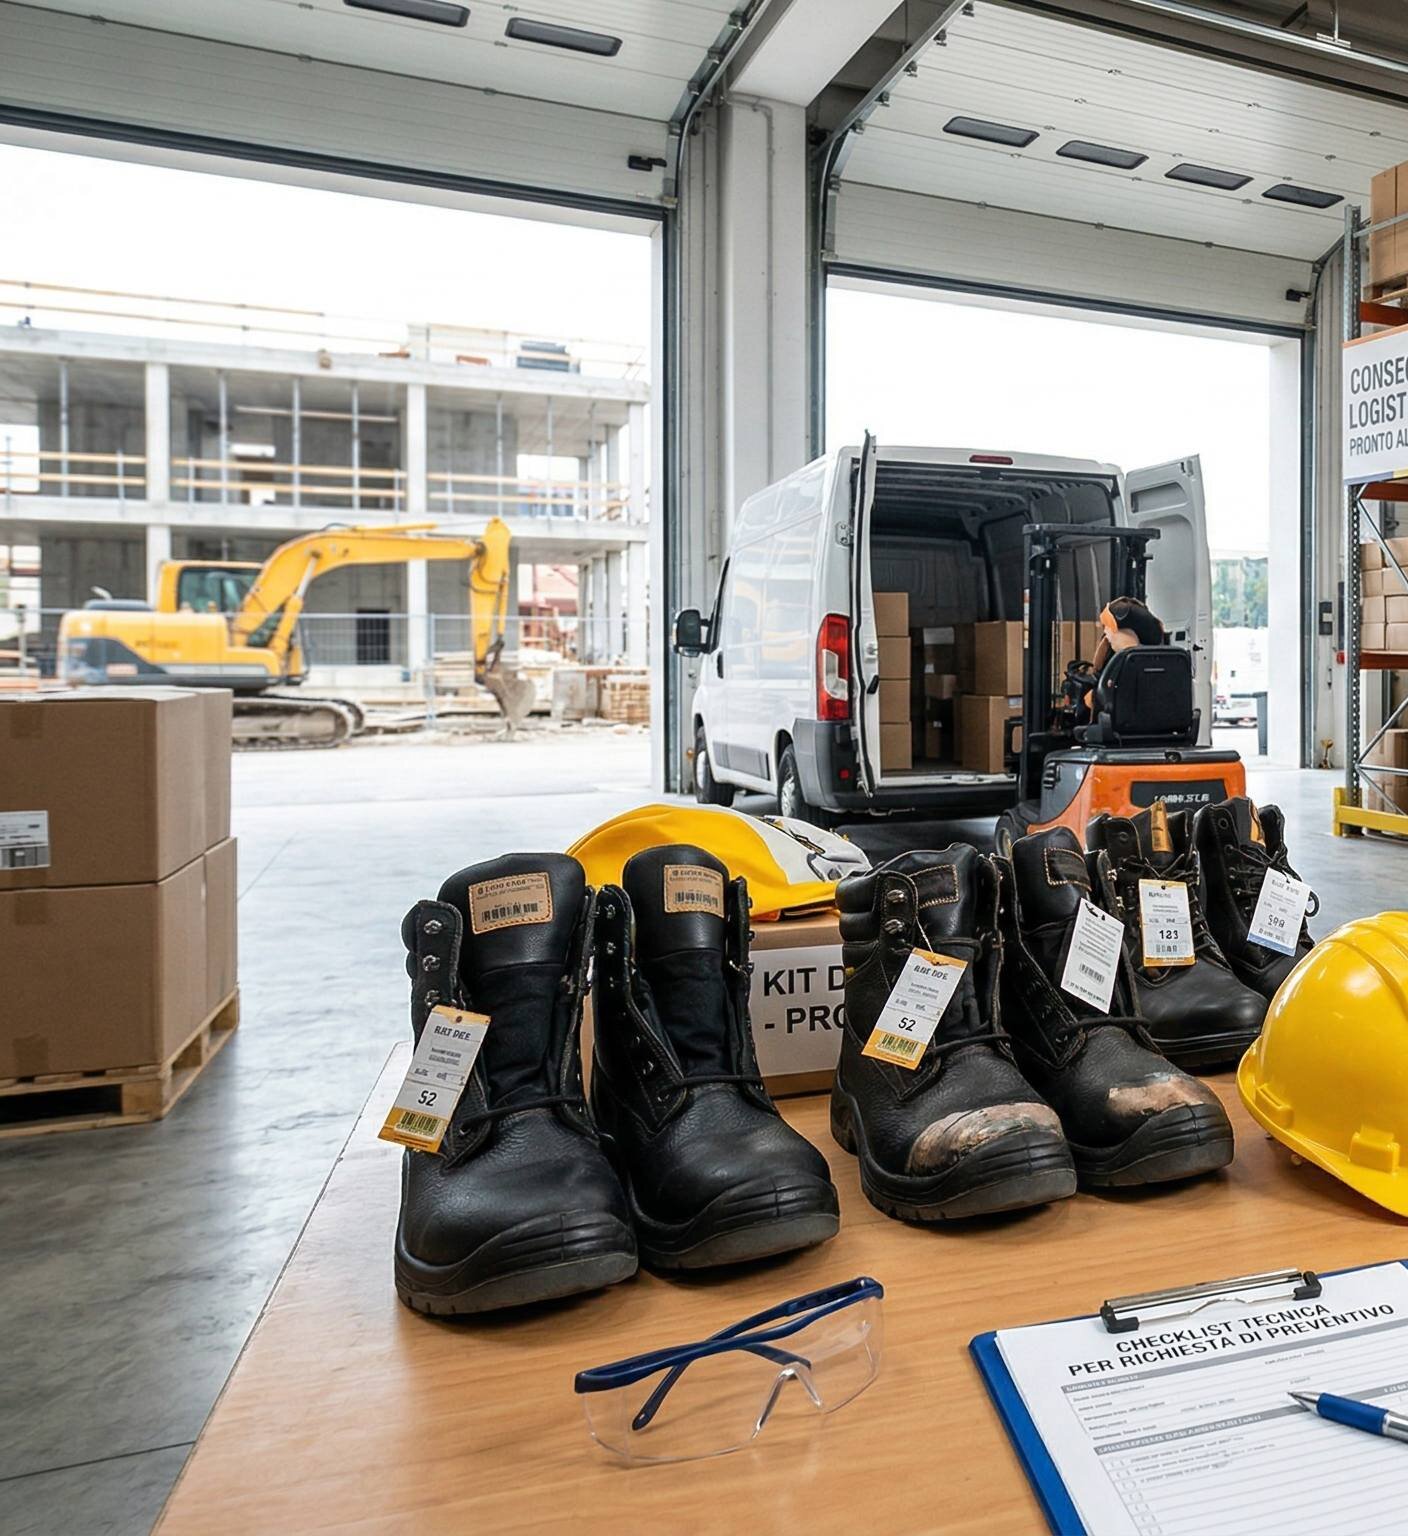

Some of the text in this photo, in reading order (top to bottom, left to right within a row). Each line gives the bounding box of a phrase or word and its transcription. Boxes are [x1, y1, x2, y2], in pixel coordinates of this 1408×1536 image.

[1349, 431, 1394, 456] PRONTO
[1159, 929, 1179, 940] 123
[763, 967, 817, 997] KIT
[1068, 1359, 1115, 1376] PER
[1119, 1336, 1236, 1368] RICHIESTA
[1238, 1330, 1262, 1344] DI
[1266, 1304, 1395, 1339] PREVENTIVO
[1116, 1304, 1331, 1353] CHECKLIST TECNICA
